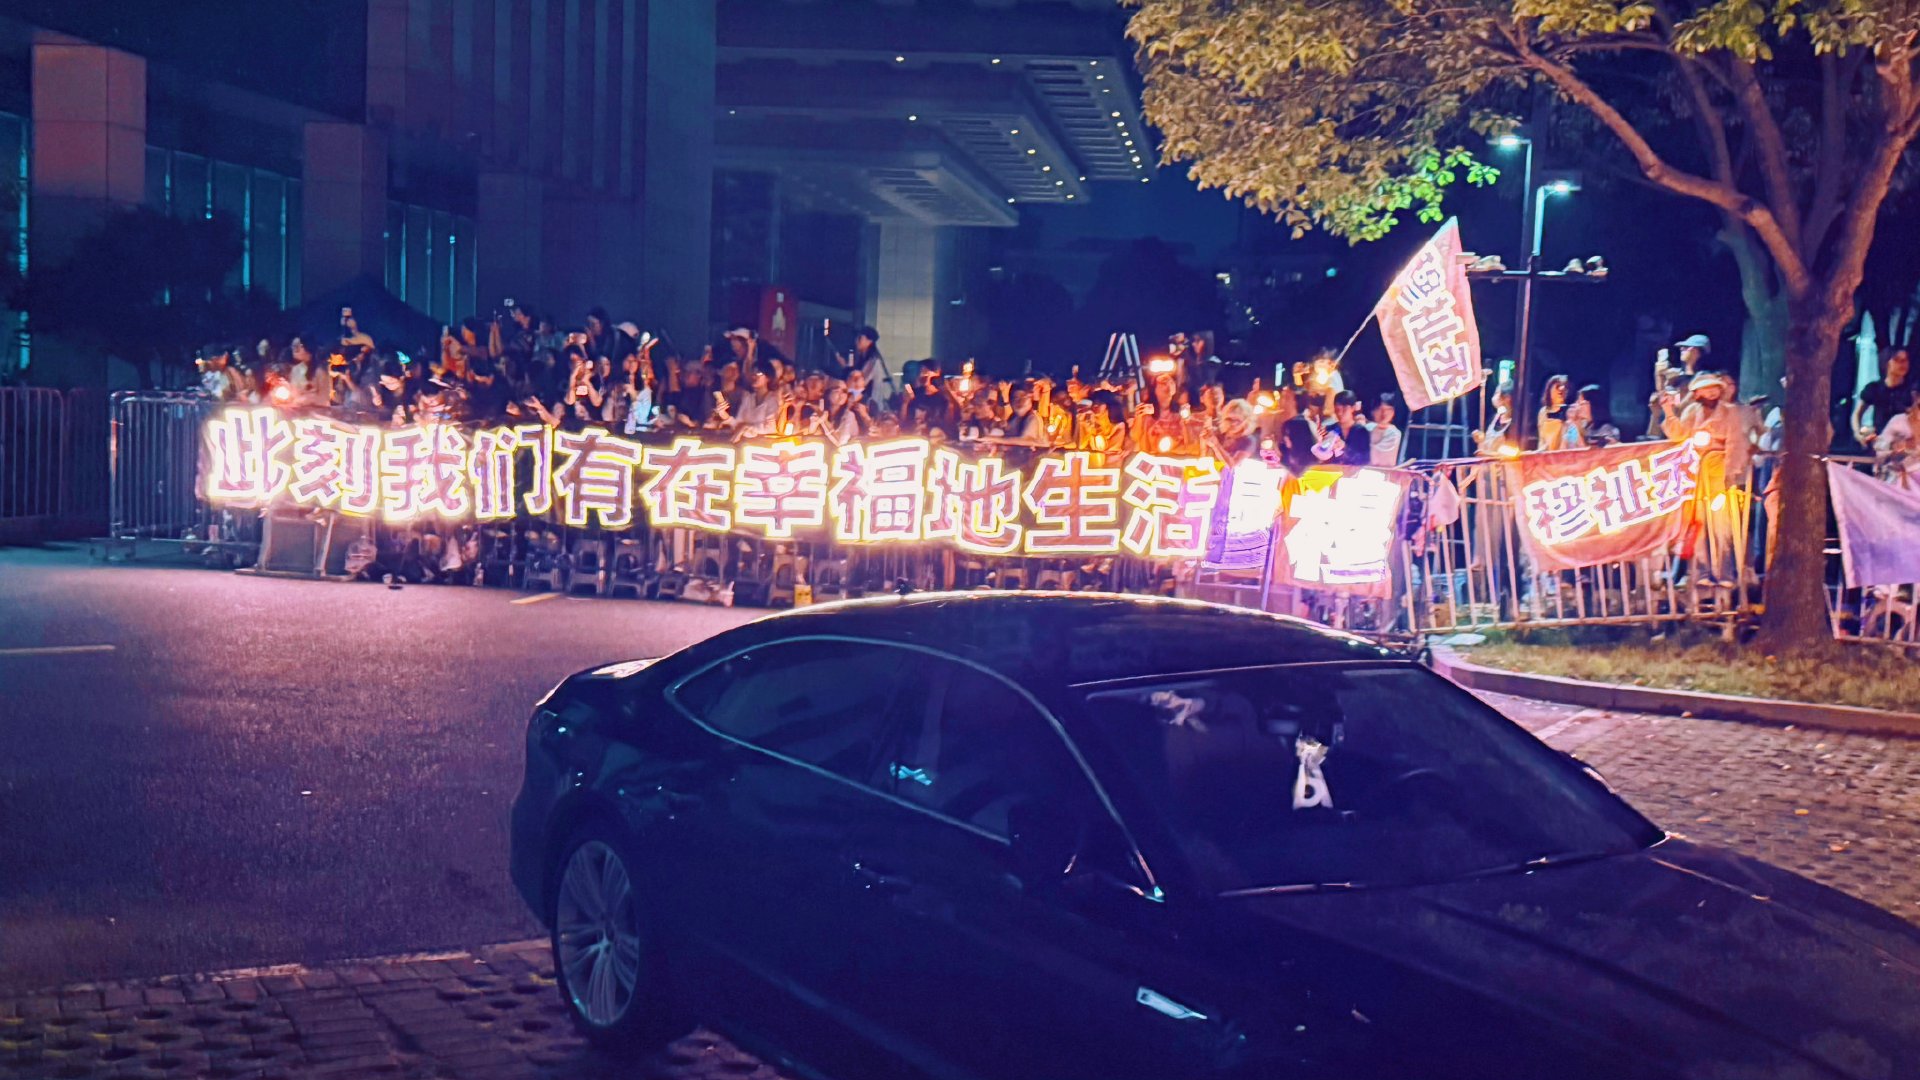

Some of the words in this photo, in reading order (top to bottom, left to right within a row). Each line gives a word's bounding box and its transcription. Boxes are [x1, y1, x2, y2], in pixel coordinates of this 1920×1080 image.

[206, 407, 1222, 556] 此刻我们有在幸福地生活
